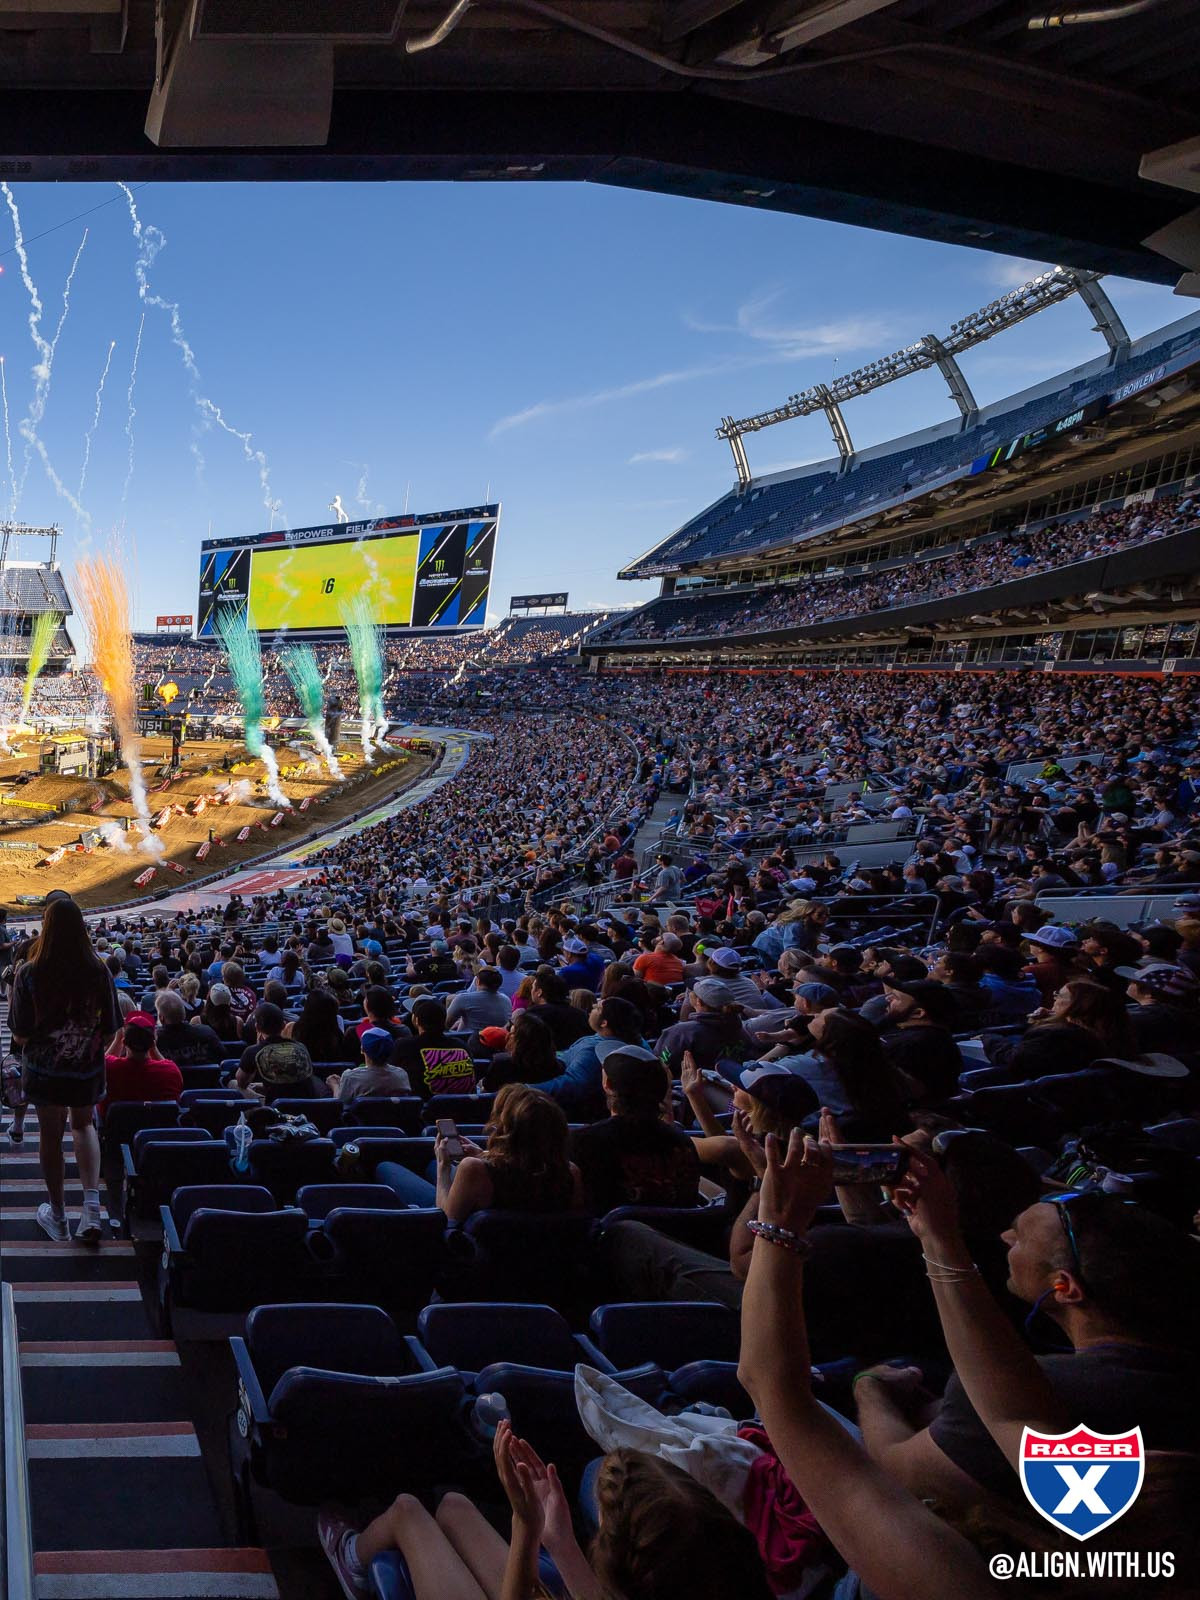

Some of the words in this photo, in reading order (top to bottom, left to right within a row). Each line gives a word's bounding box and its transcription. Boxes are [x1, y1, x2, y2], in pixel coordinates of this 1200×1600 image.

[1122, 372, 1155, 397] BOWLEN
[1055, 409, 1085, 432] 4:48PM
[285, 528, 333, 541] EMPOWER
[345, 522, 375, 534] FIELD
